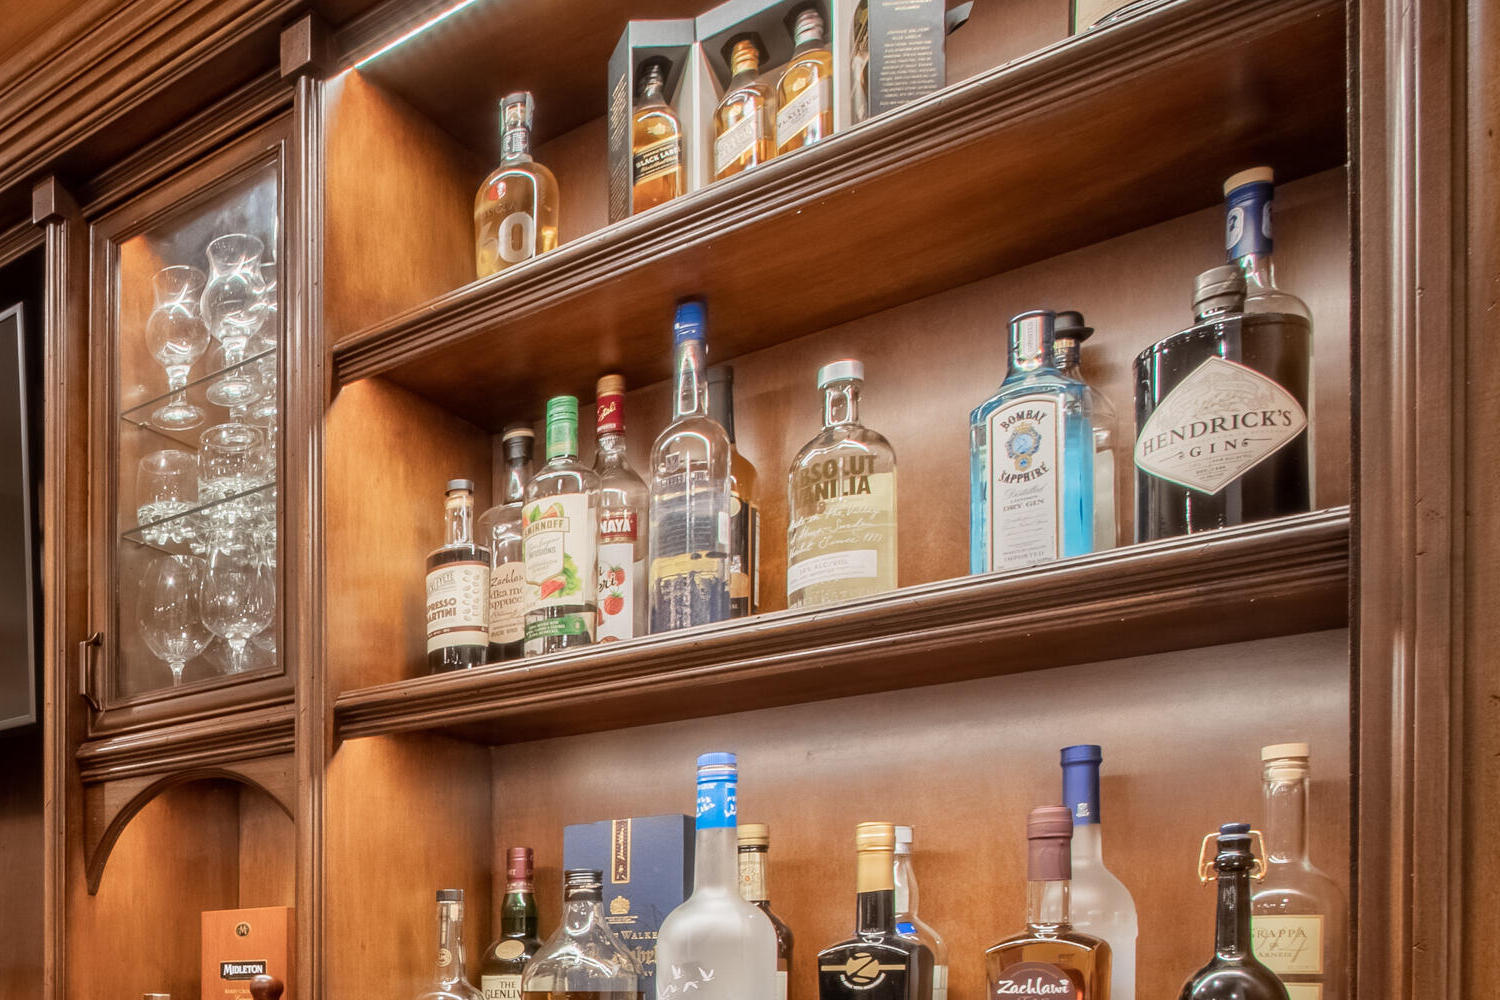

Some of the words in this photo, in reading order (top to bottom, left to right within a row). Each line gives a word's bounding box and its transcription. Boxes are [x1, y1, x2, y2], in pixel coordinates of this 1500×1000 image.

[999, 409, 1047, 433] BOMBAY
[1142, 409, 1292, 457] HENDRICK'S
[1189, 438, 1238, 458] GIN
[998, 461, 1050, 484] SAPPHIRE
[223, 963, 264, 977] MIDLETON
[500, 980, 516, 988] THE
[996, 976, 1070, 996] Zachlawi
